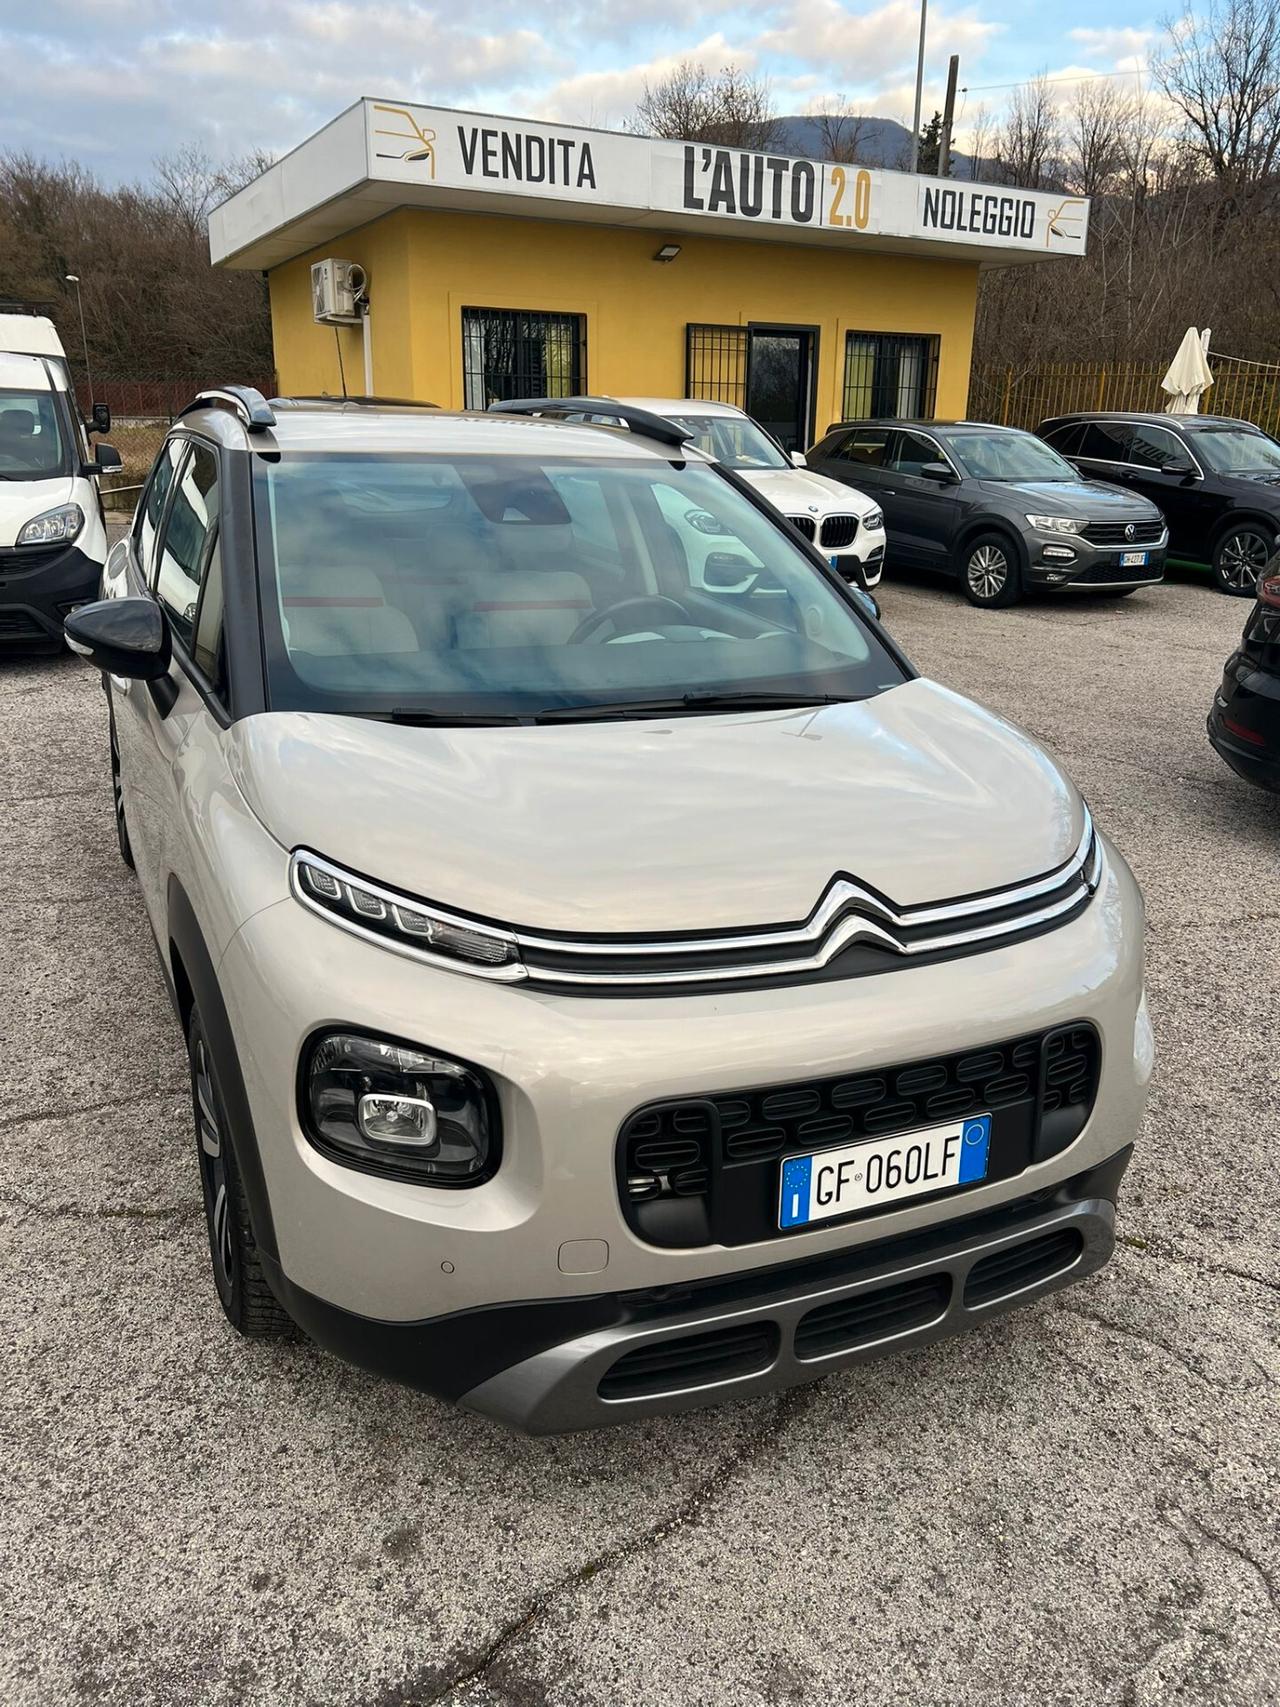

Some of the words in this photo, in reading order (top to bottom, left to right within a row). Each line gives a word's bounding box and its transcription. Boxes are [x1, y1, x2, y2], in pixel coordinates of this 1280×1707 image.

[457, 126, 597, 189] VENDITA
[684, 146, 814, 222] L'AUTO
[830, 167, 871, 230] 2.0
[923, 188, 1036, 238] NOLEGGIO
[817, 1160, 854, 1205] GF
[866, 1136, 959, 1193] 060LF
